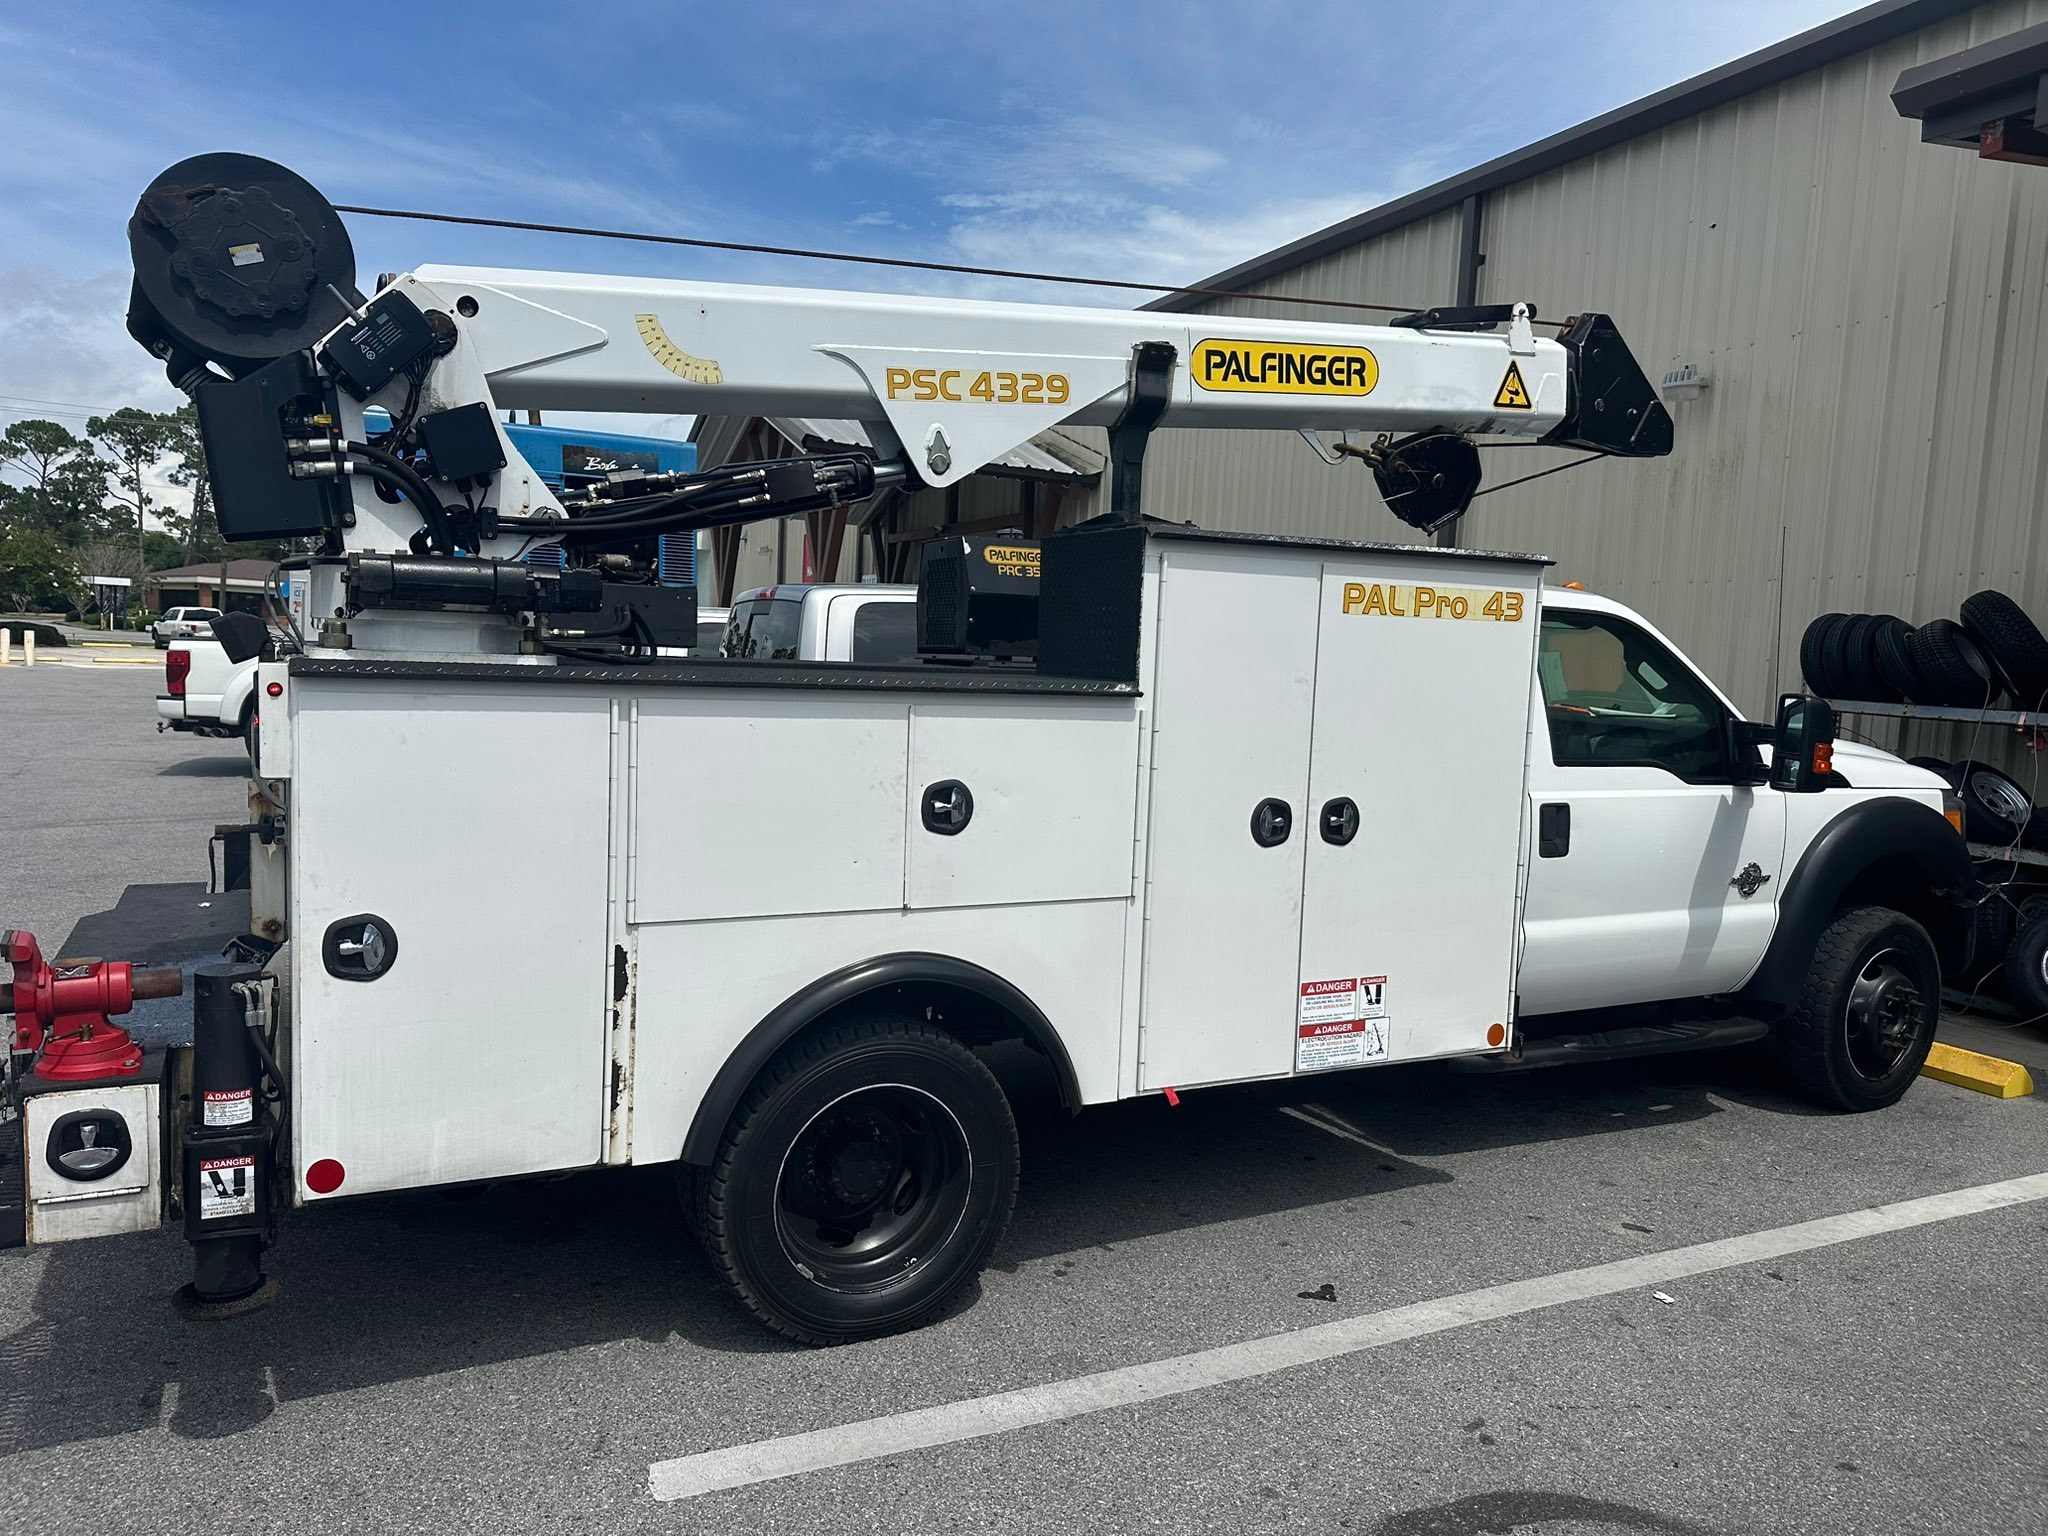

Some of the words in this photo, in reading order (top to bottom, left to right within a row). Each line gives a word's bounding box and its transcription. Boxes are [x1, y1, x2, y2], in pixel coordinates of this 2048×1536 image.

[1205, 349, 1366, 387] PALFINGER
[886, 368, 962, 401] PSC
[969, 371, 1070, 404] 4329
[989, 549, 1041, 563] PALFINGE
[997, 565, 1023, 577] PRC
[1342, 582, 1405, 617] PAL
[1413, 586, 1469, 620] Pro
[1482, 591, 1524, 622] 43
[1316, 981, 1352, 992] DANGER
[1322, 1024, 1352, 1033] DANGER
[215, 1090, 251, 1100] DANGER
[213, 1157, 252, 1168] DANGER
